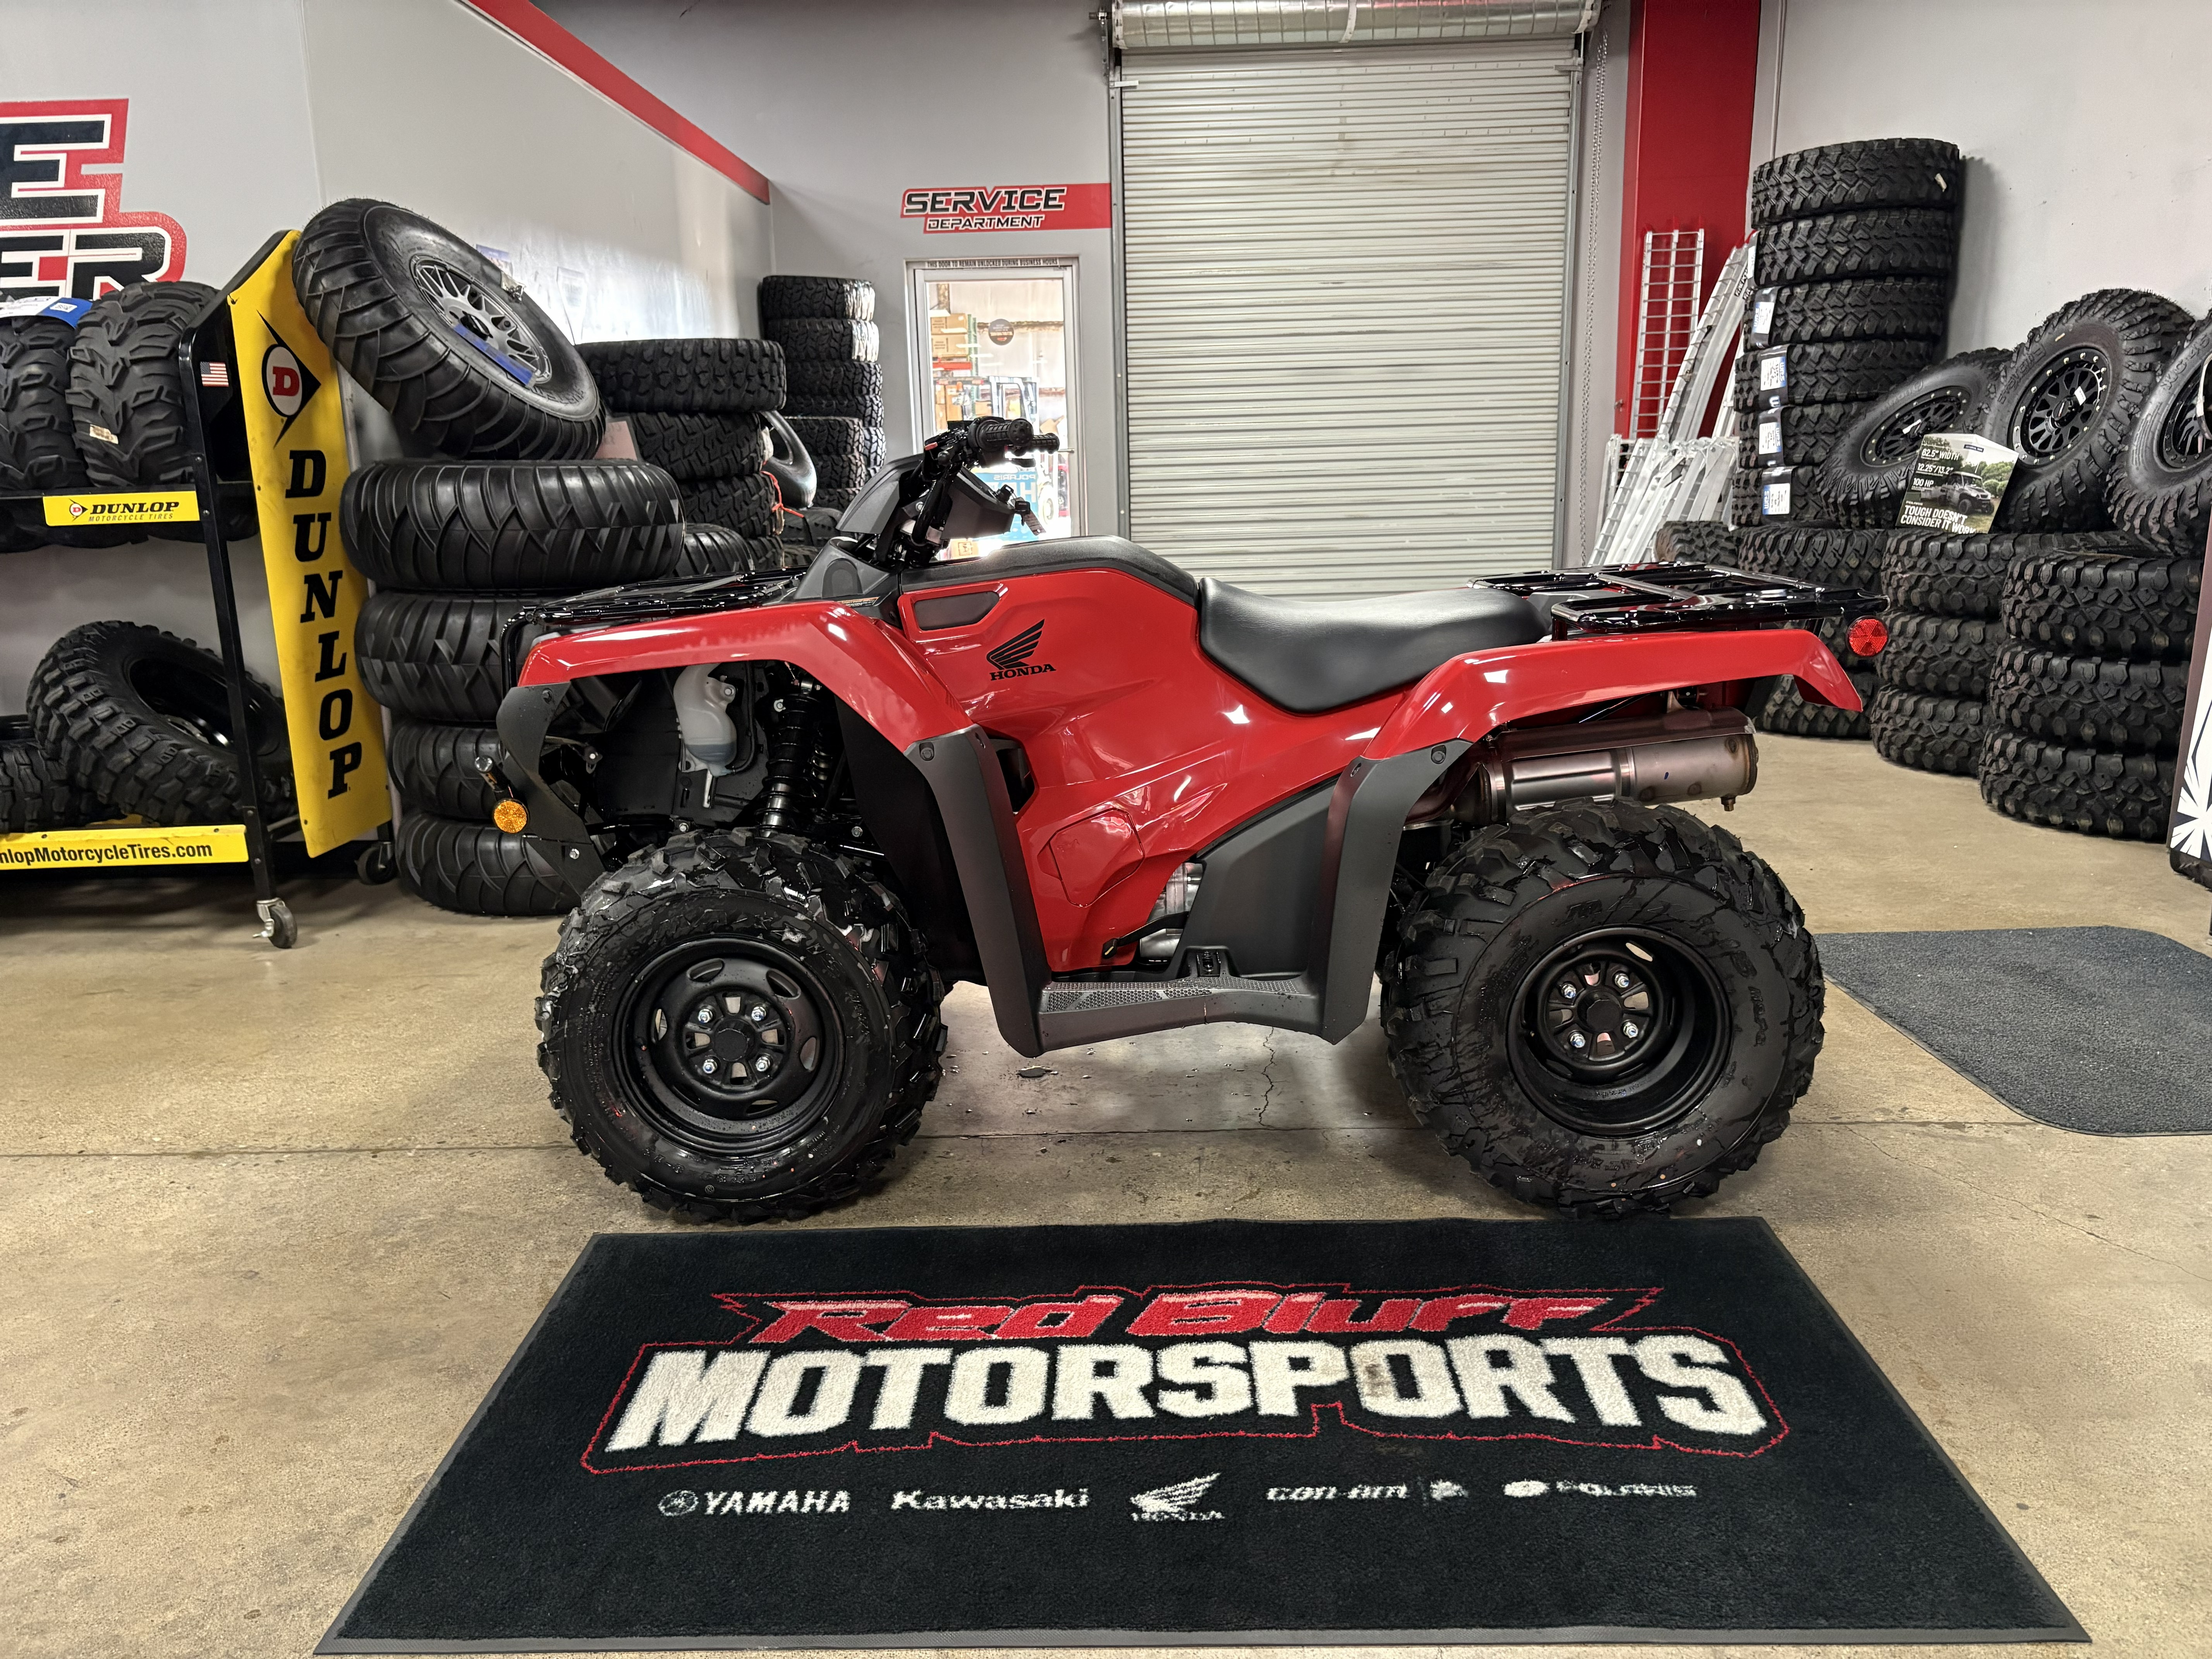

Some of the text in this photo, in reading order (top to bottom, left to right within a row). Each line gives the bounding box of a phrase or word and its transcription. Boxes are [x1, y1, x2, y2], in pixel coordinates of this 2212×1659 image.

[904, 187, 1067, 213] SERVICE
[927, 215, 1045, 231] DEPARTMENT
[1922, 448, 1939, 457] 62.5"
[1939, 450, 1960, 460] WIDTH
[1913, 477, 1934, 488] 100 HP
[90, 501, 179, 514] DUNLOP
[1905, 505, 1968, 525] TOUGH DOESN'T
[1900, 514, 1942, 528] CONSIDER
[1941, 519, 1951, 530] IT
[286, 450, 362, 799] DUNLOP
[990, 663, 1057, 681] HONDA
[749, 1289, 1611, 1343] Red Bluff
[605, 1334, 1767, 1453] MOTORSPORTS
[704, 1490, 850, 1515] YAMAHA
[890, 1488, 1089, 1510] Kawasaki
